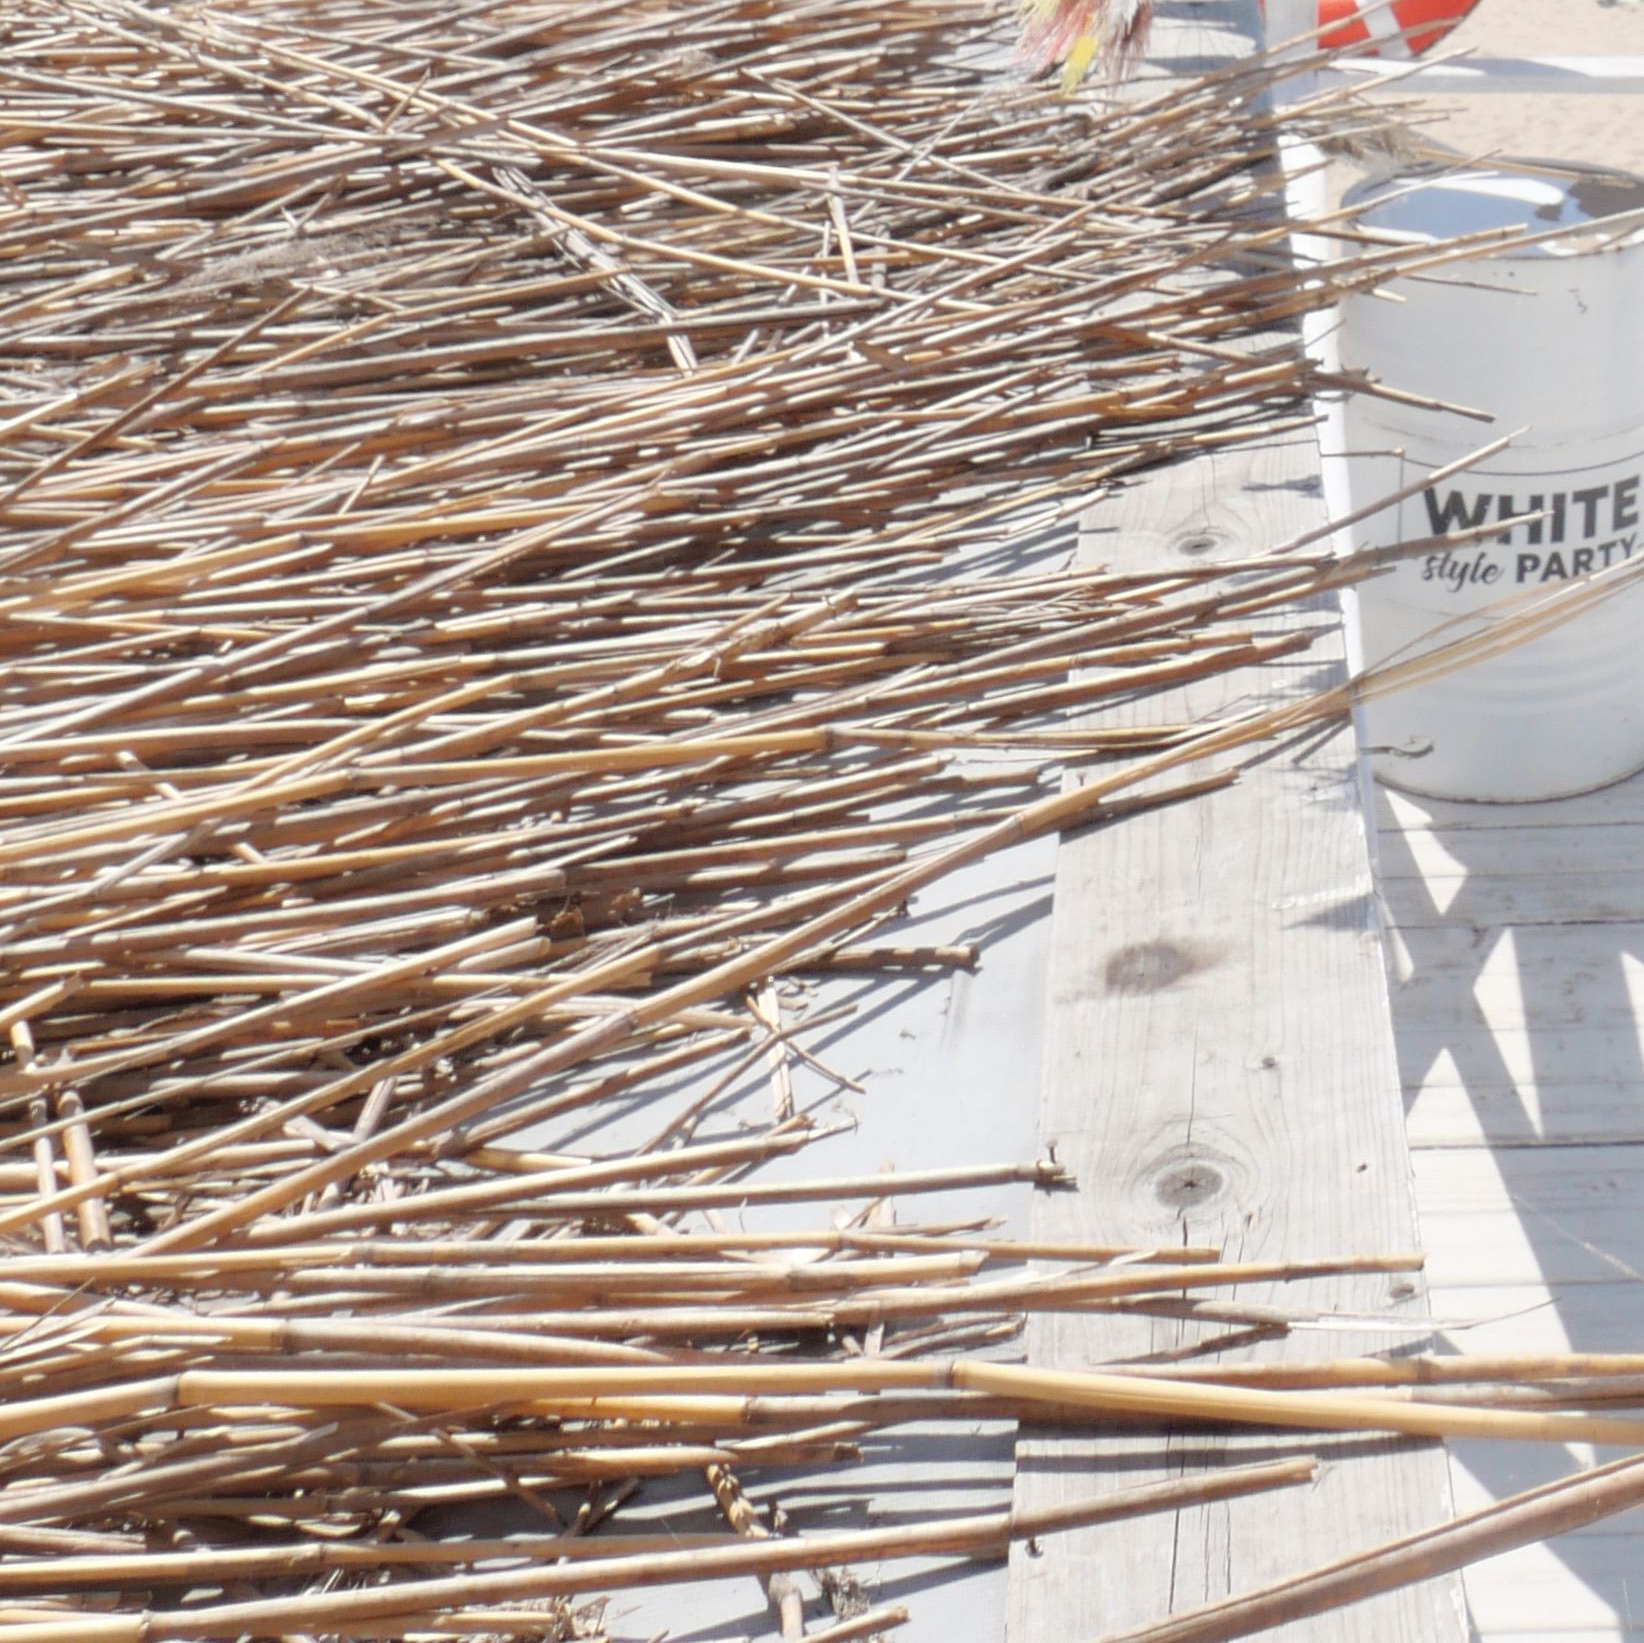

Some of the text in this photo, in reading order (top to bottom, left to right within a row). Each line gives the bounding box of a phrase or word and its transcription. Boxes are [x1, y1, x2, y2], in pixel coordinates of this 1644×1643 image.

[1423, 475, 1640, 544] WHITE
[1421, 533, 1638, 592] style PARTY
